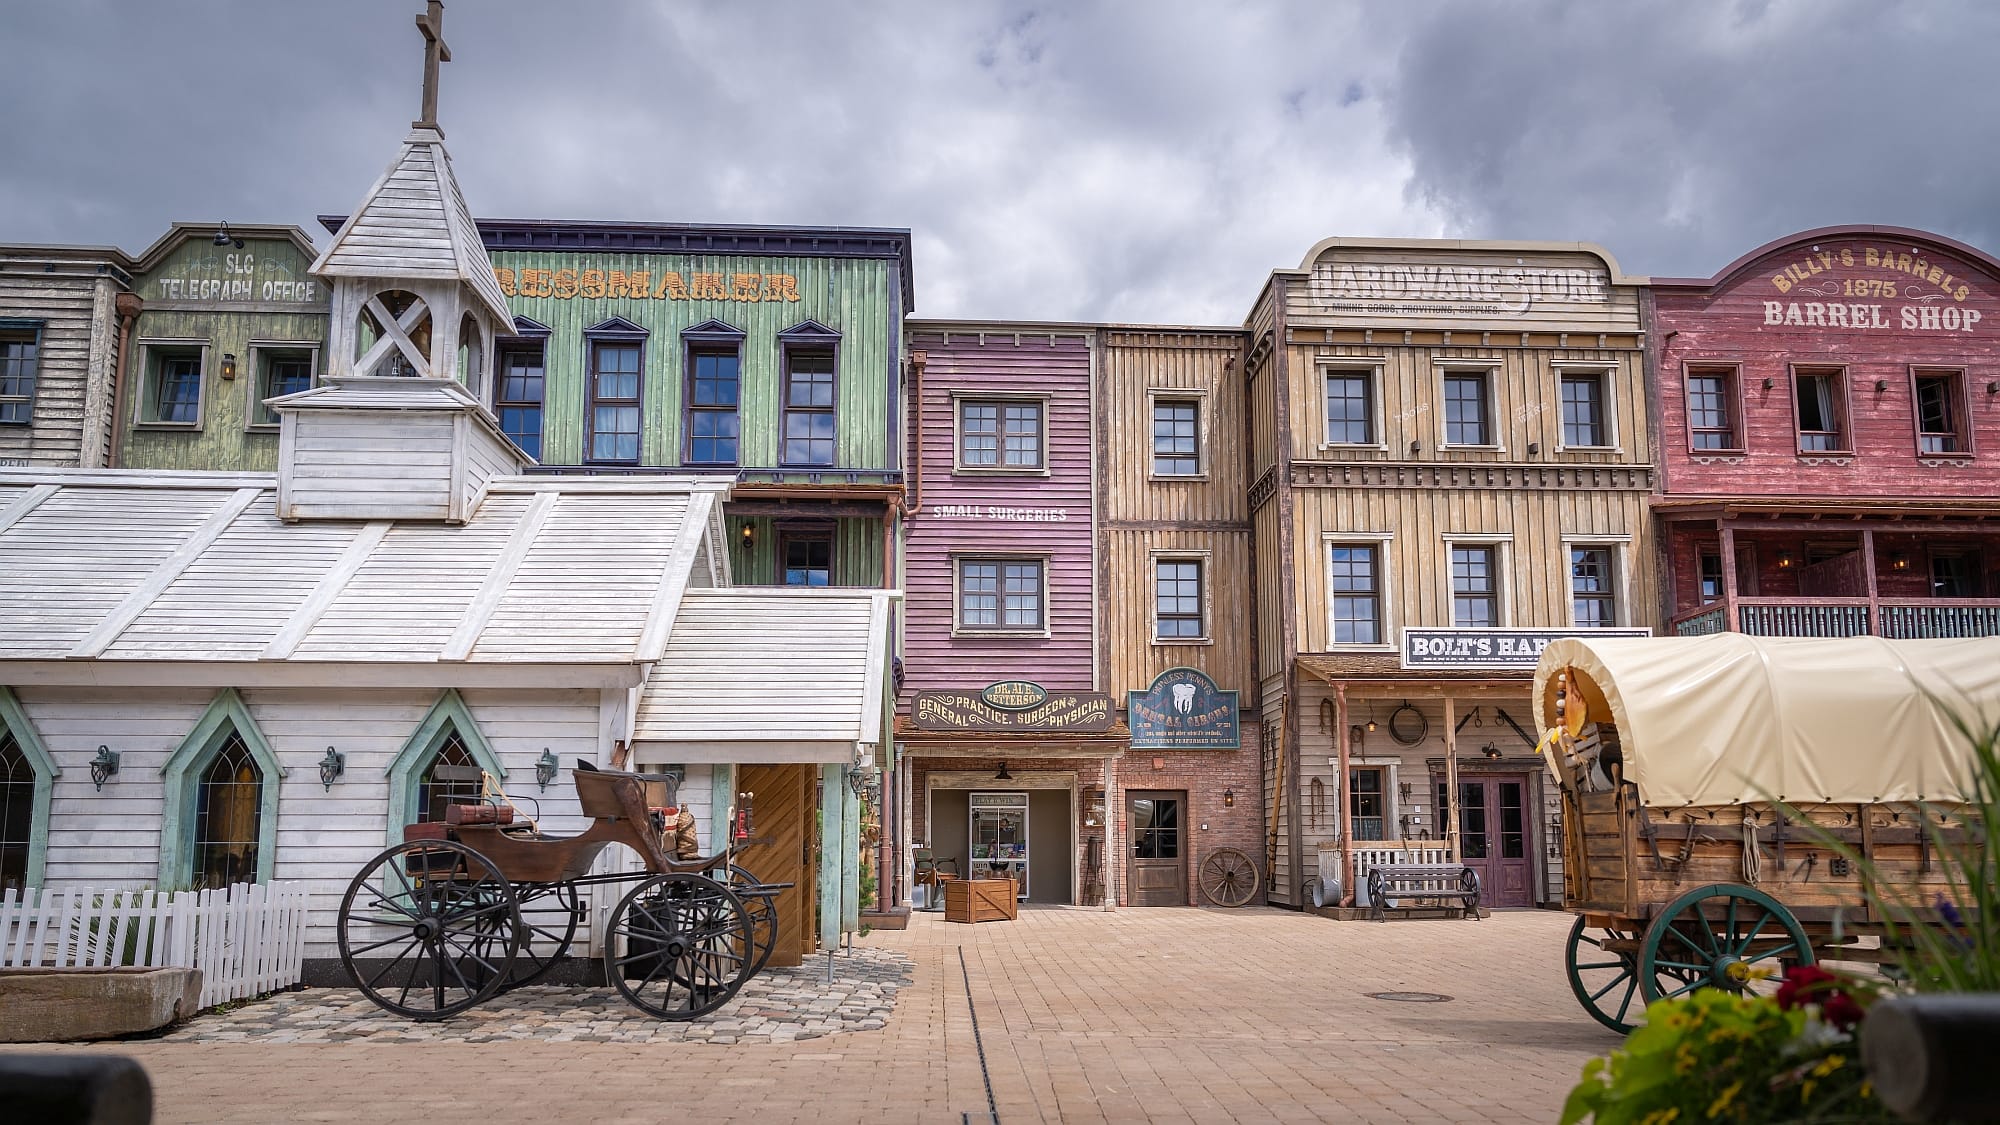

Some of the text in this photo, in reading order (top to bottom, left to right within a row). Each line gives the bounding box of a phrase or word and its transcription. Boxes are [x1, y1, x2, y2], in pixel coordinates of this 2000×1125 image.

[225, 253, 254, 274] SLC
[492, 267, 801, 302] RESSMAKER
[1771, 247, 1970, 302] BILLY'S BARRELS
[159, 278, 317, 302] TELEGRAPH OFFICE
[1312, 263, 1610, 316] HARDWARE STORE
[1843, 279, 1897, 298] 1875
[1332, 303, 1364, 313] MINING
[1763, 300, 1982, 332] BARREL SHOP
[933, 505, 1067, 521] SMALL SURGERIES
[1412, 637, 1553, 656] BOLT'S HAR
[994, 683, 1011, 695] DR.
[986, 694, 1043, 706] BETTERSON
[919, 698, 970, 727] GENERAL
[1017, 697, 1067, 724] SURGEON
[1049, 699, 1107, 727] PHYSICIAN
